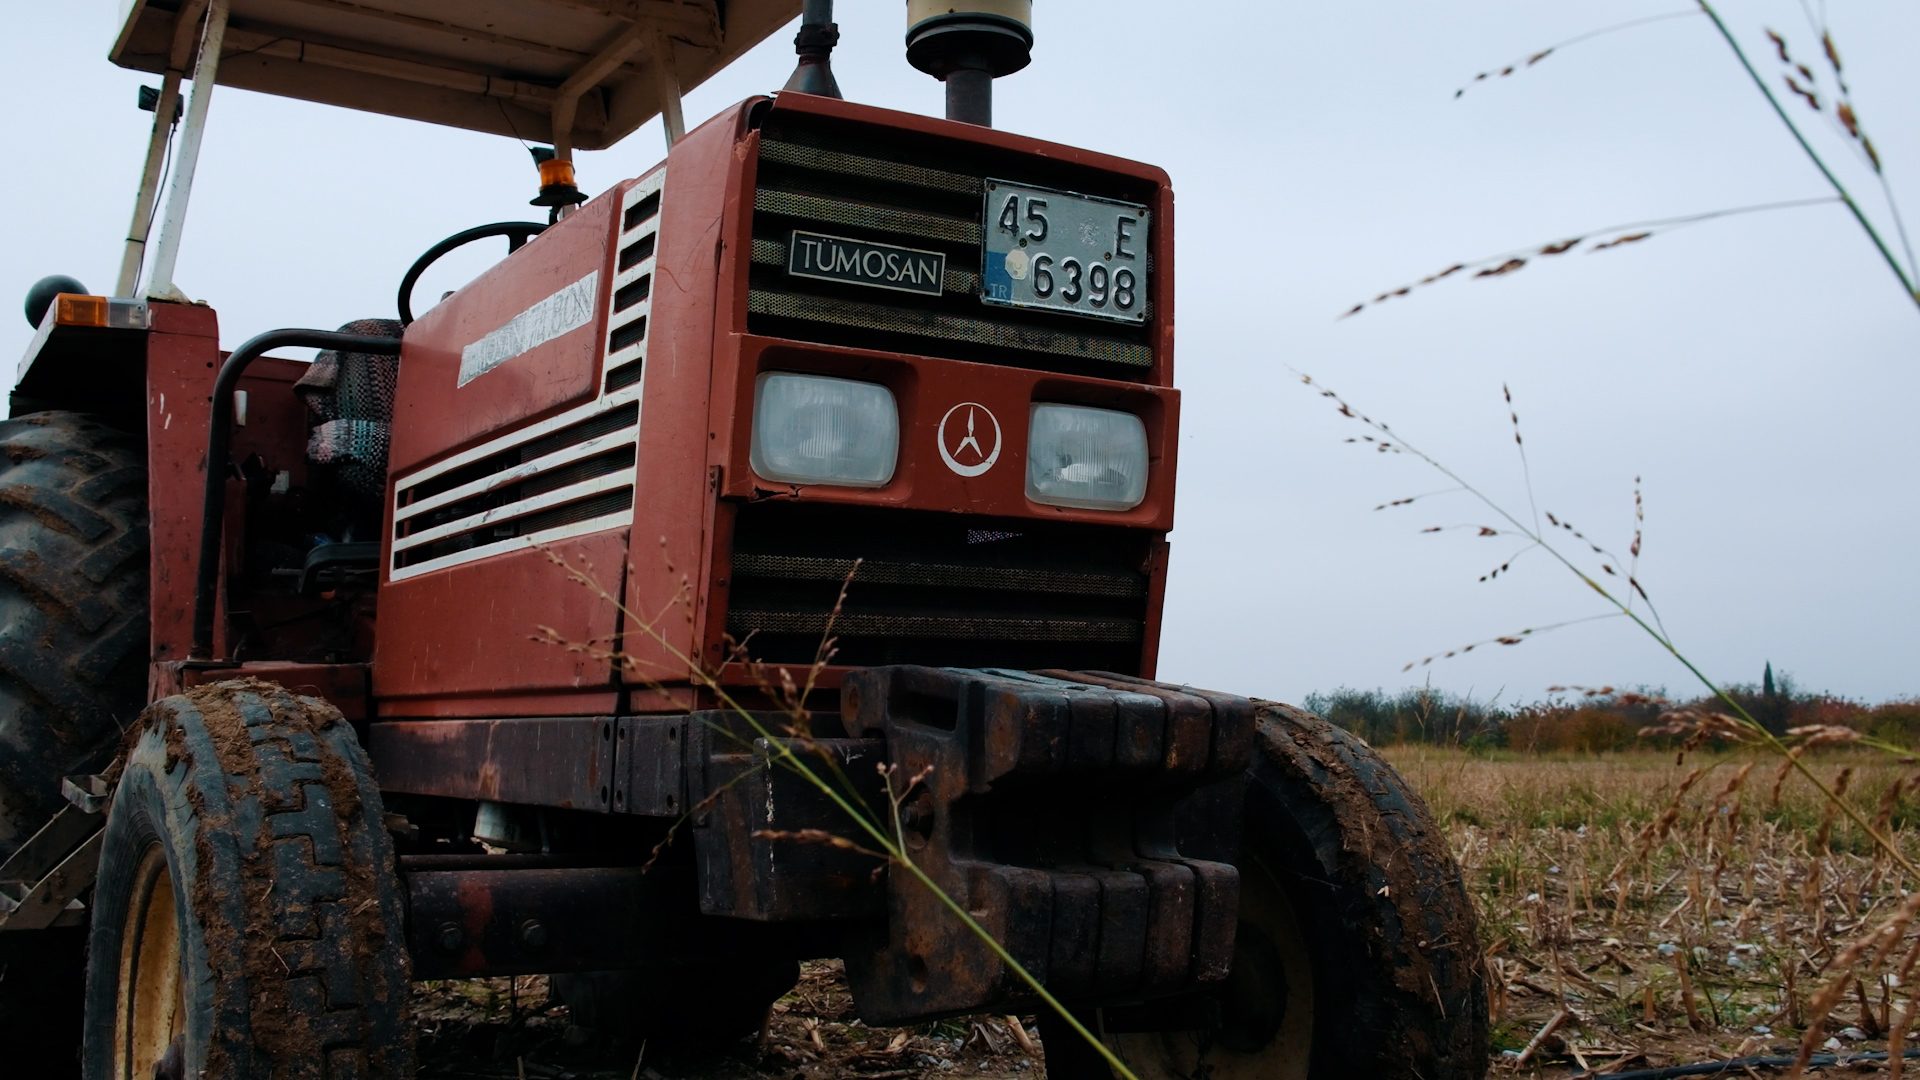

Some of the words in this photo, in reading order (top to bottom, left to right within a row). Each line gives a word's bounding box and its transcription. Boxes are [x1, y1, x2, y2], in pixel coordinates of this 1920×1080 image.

[999, 195, 1048, 241] 45
[1116, 215, 1137, 261] E
[800, 238, 938, 285] TÜMOSAN
[1033, 255, 1136, 310] 6398
[990, 283, 1008, 299] TR
